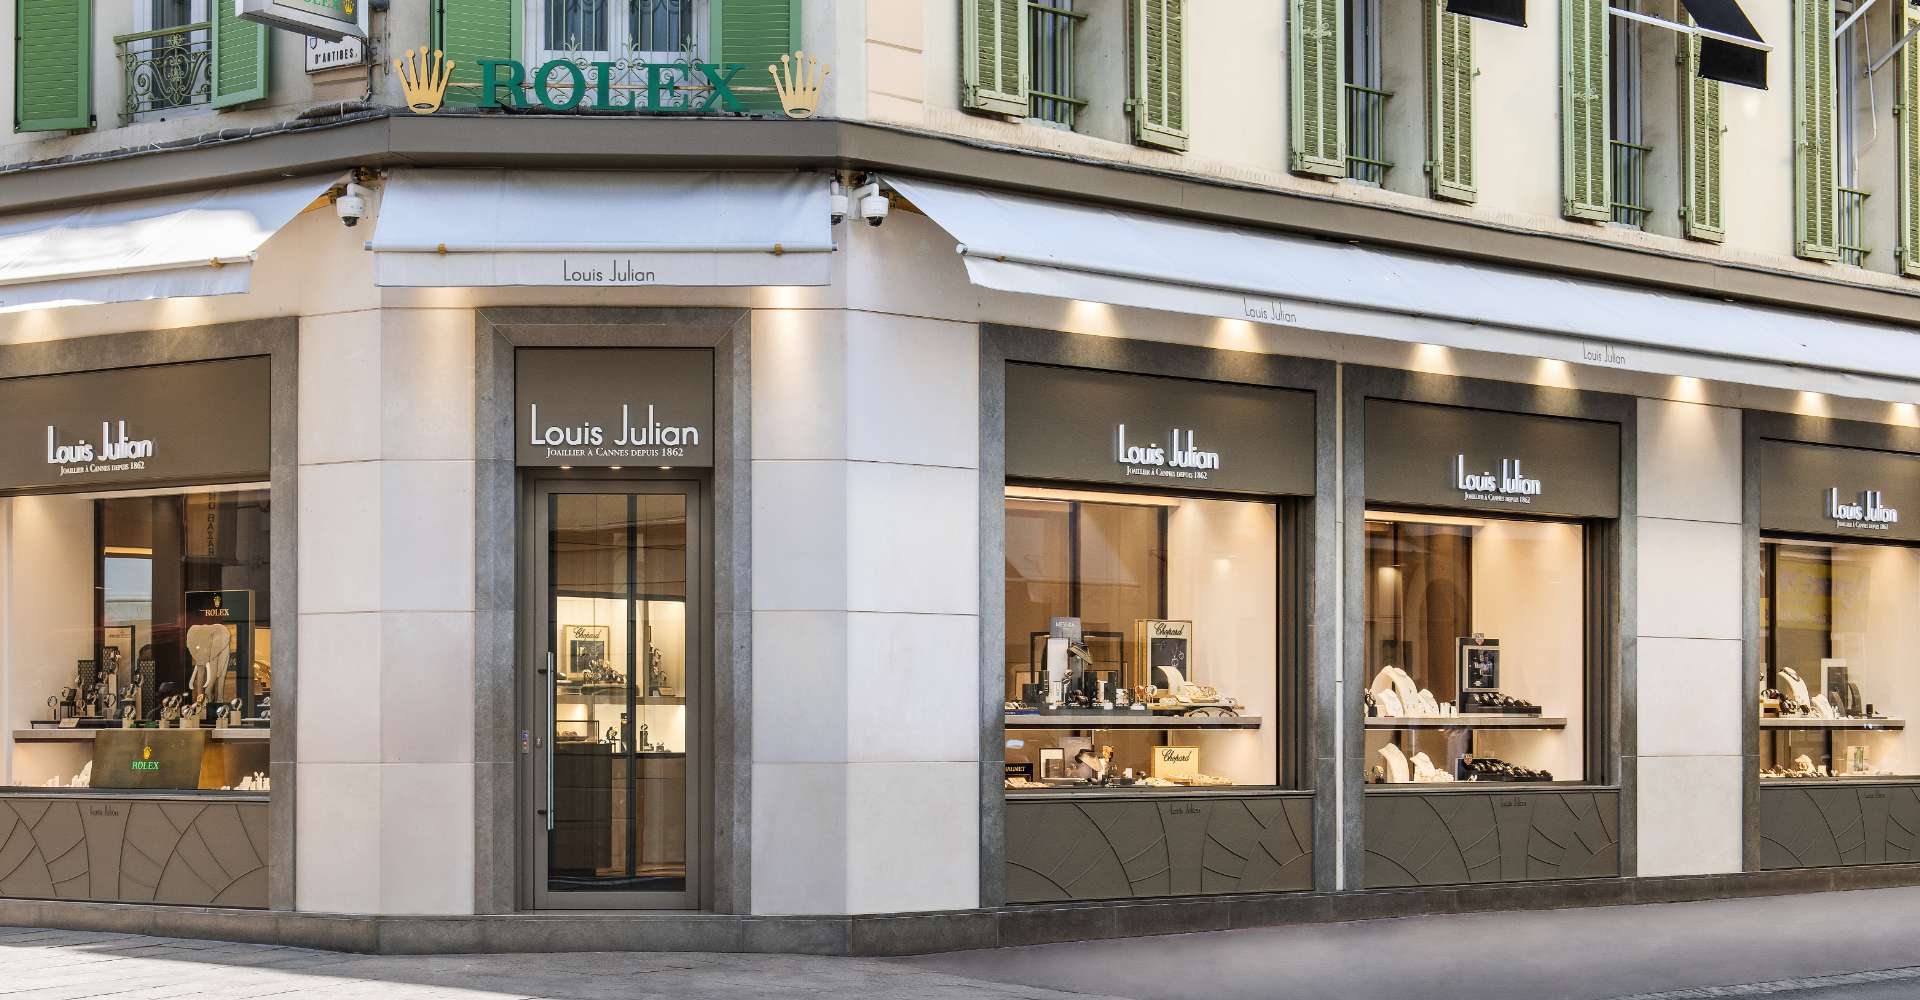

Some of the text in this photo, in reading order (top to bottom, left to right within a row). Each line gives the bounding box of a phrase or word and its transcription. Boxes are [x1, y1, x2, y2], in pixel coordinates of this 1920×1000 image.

[477, 59, 747, 112] ROLEX
[563, 259, 655, 281] Louis Julian
[1243, 296, 1297, 322] Louis Julian
[1582, 340, 1626, 364] Louis Julian
[532, 403, 699, 446] Louis Julian
[47, 420, 154, 464] Louis Julian
[661, 447, 684, 457] 1862
[1119, 423, 1220, 470] Louis Julian
[131, 461, 145, 470] 1862
[1194, 471, 1208, 480] 1862
[1458, 454, 1542, 495] Louis Julian
[1832, 487, 1898, 523] Louis Julian
[205, 608, 230, 617] ROLEX
[573, 626, 601, 640] Chopard
[1153, 622, 1185, 638] Chopard
[132, 761, 160, 770] ROLEX
[1161, 748, 1192, 764] Chopard
